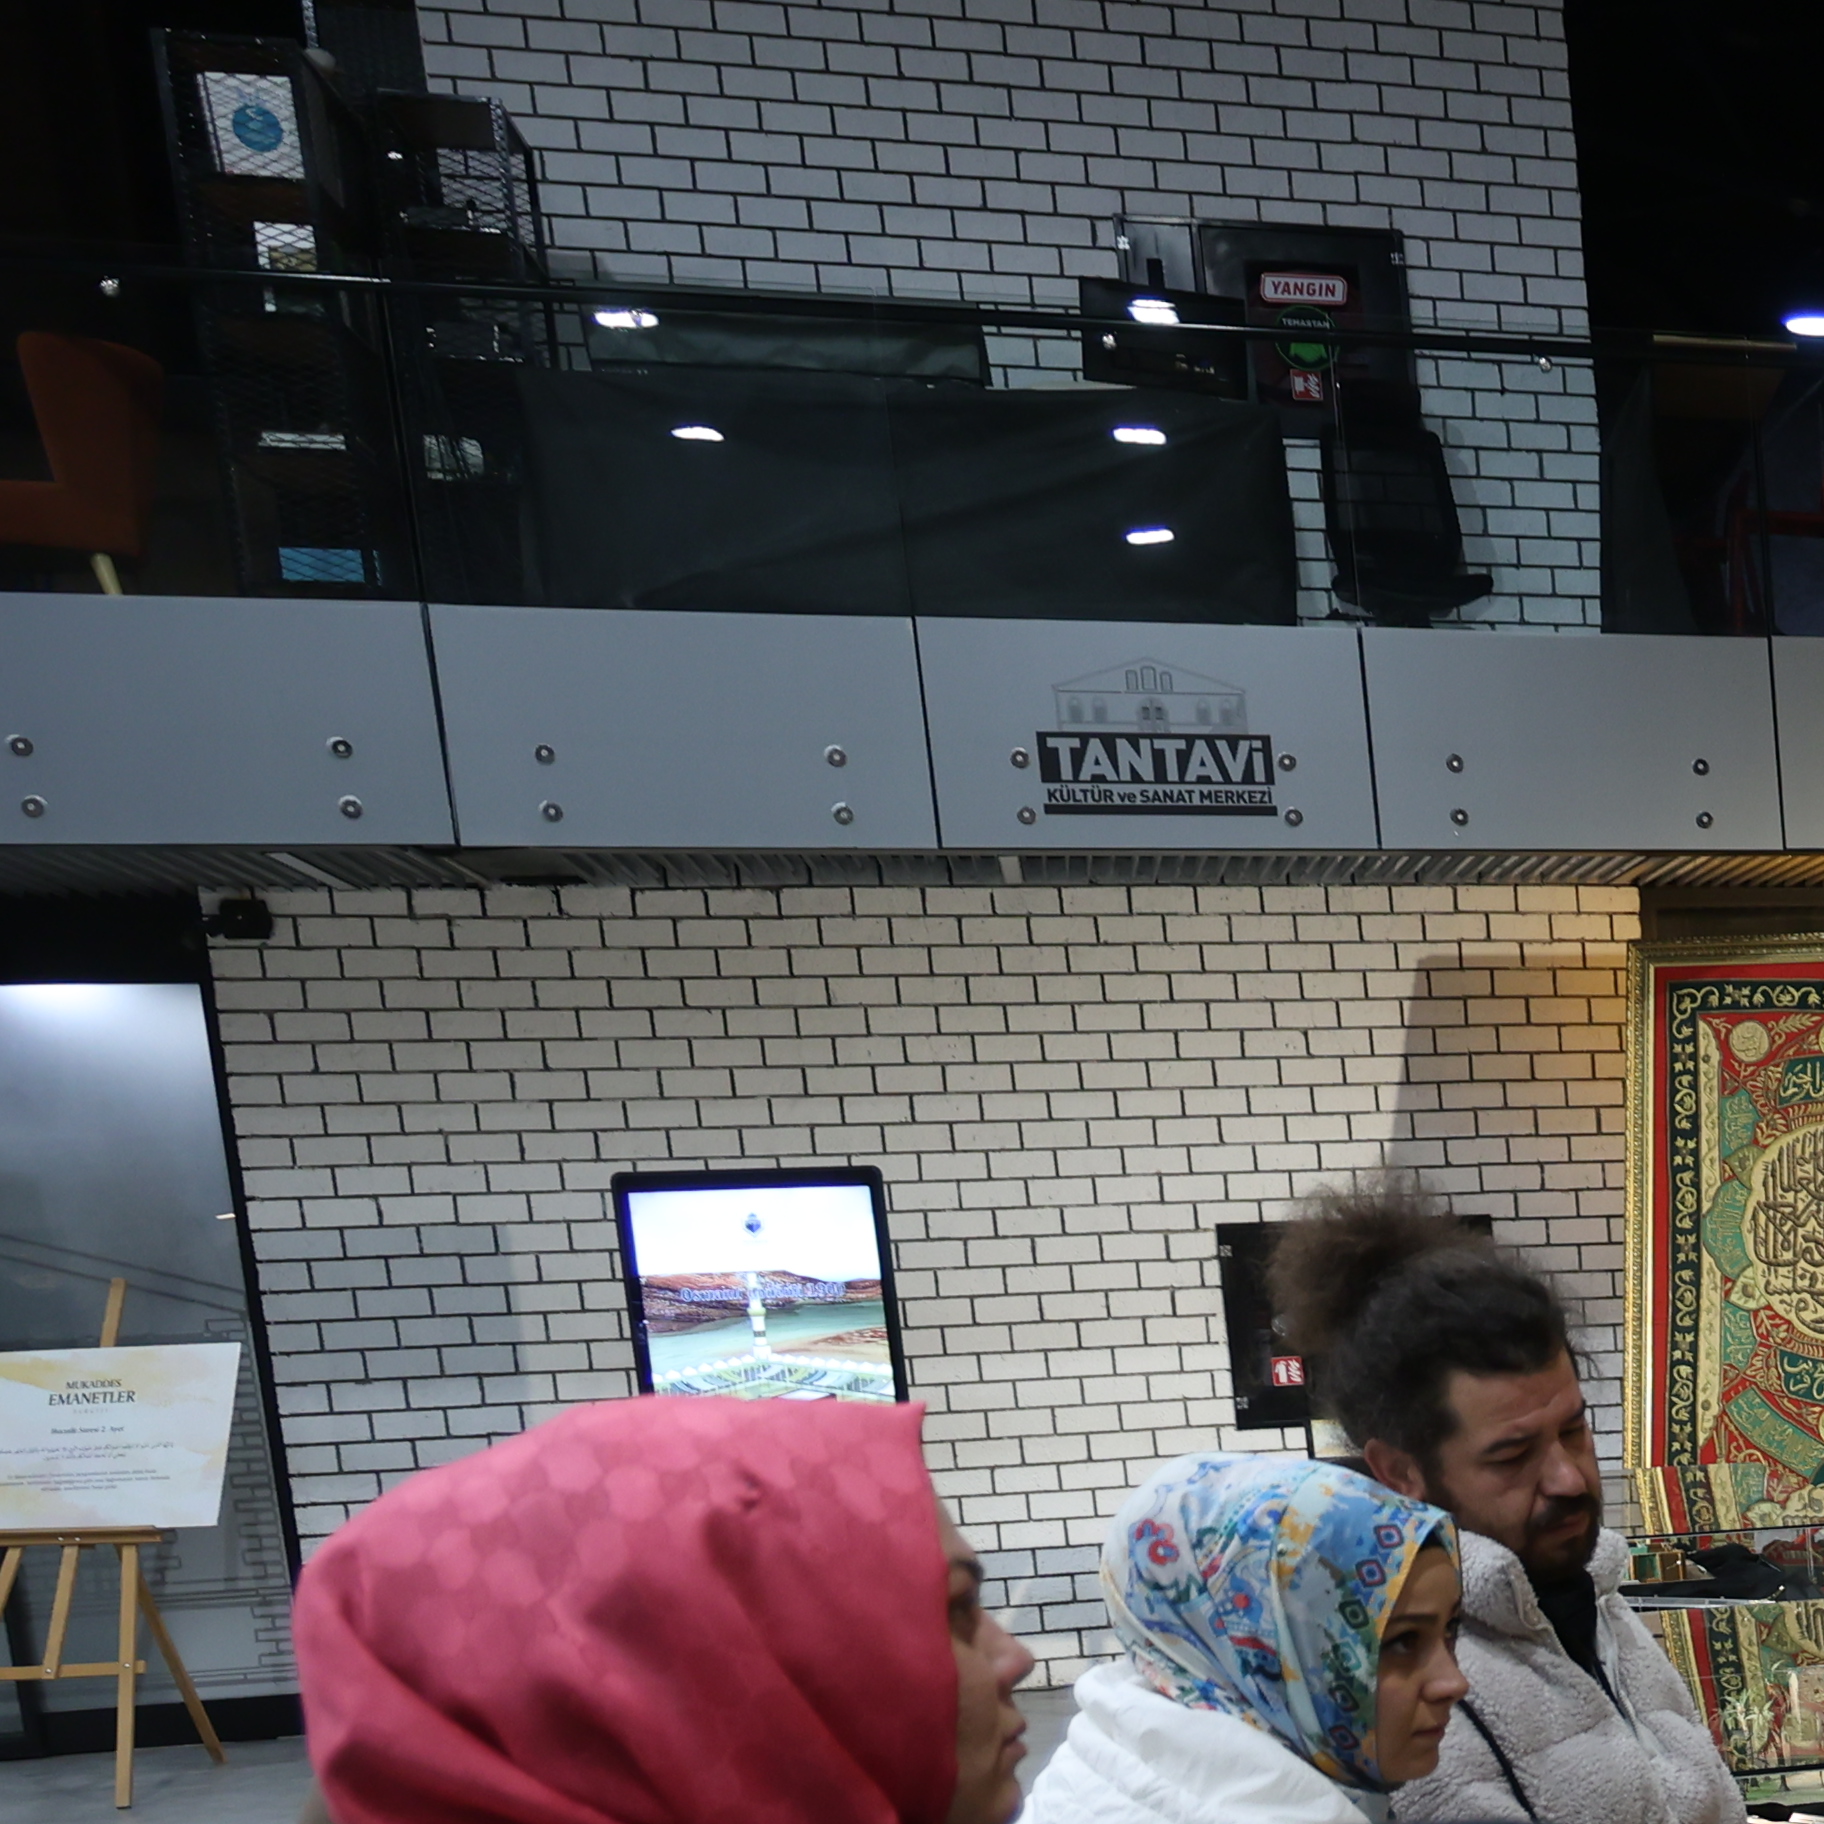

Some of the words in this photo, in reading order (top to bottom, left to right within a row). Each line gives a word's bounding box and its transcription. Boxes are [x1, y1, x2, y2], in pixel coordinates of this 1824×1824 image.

[1271, 280, 1336, 297] YANGIN
[1047, 785, 1114, 803] KÜLTÜR
[1117, 792, 1137, 804] ve
[1140, 789, 1196, 804] SANAT
[1200, 787, 1273, 805] MERKEZİ
[48, 1391, 136, 1406] EMANETLER
